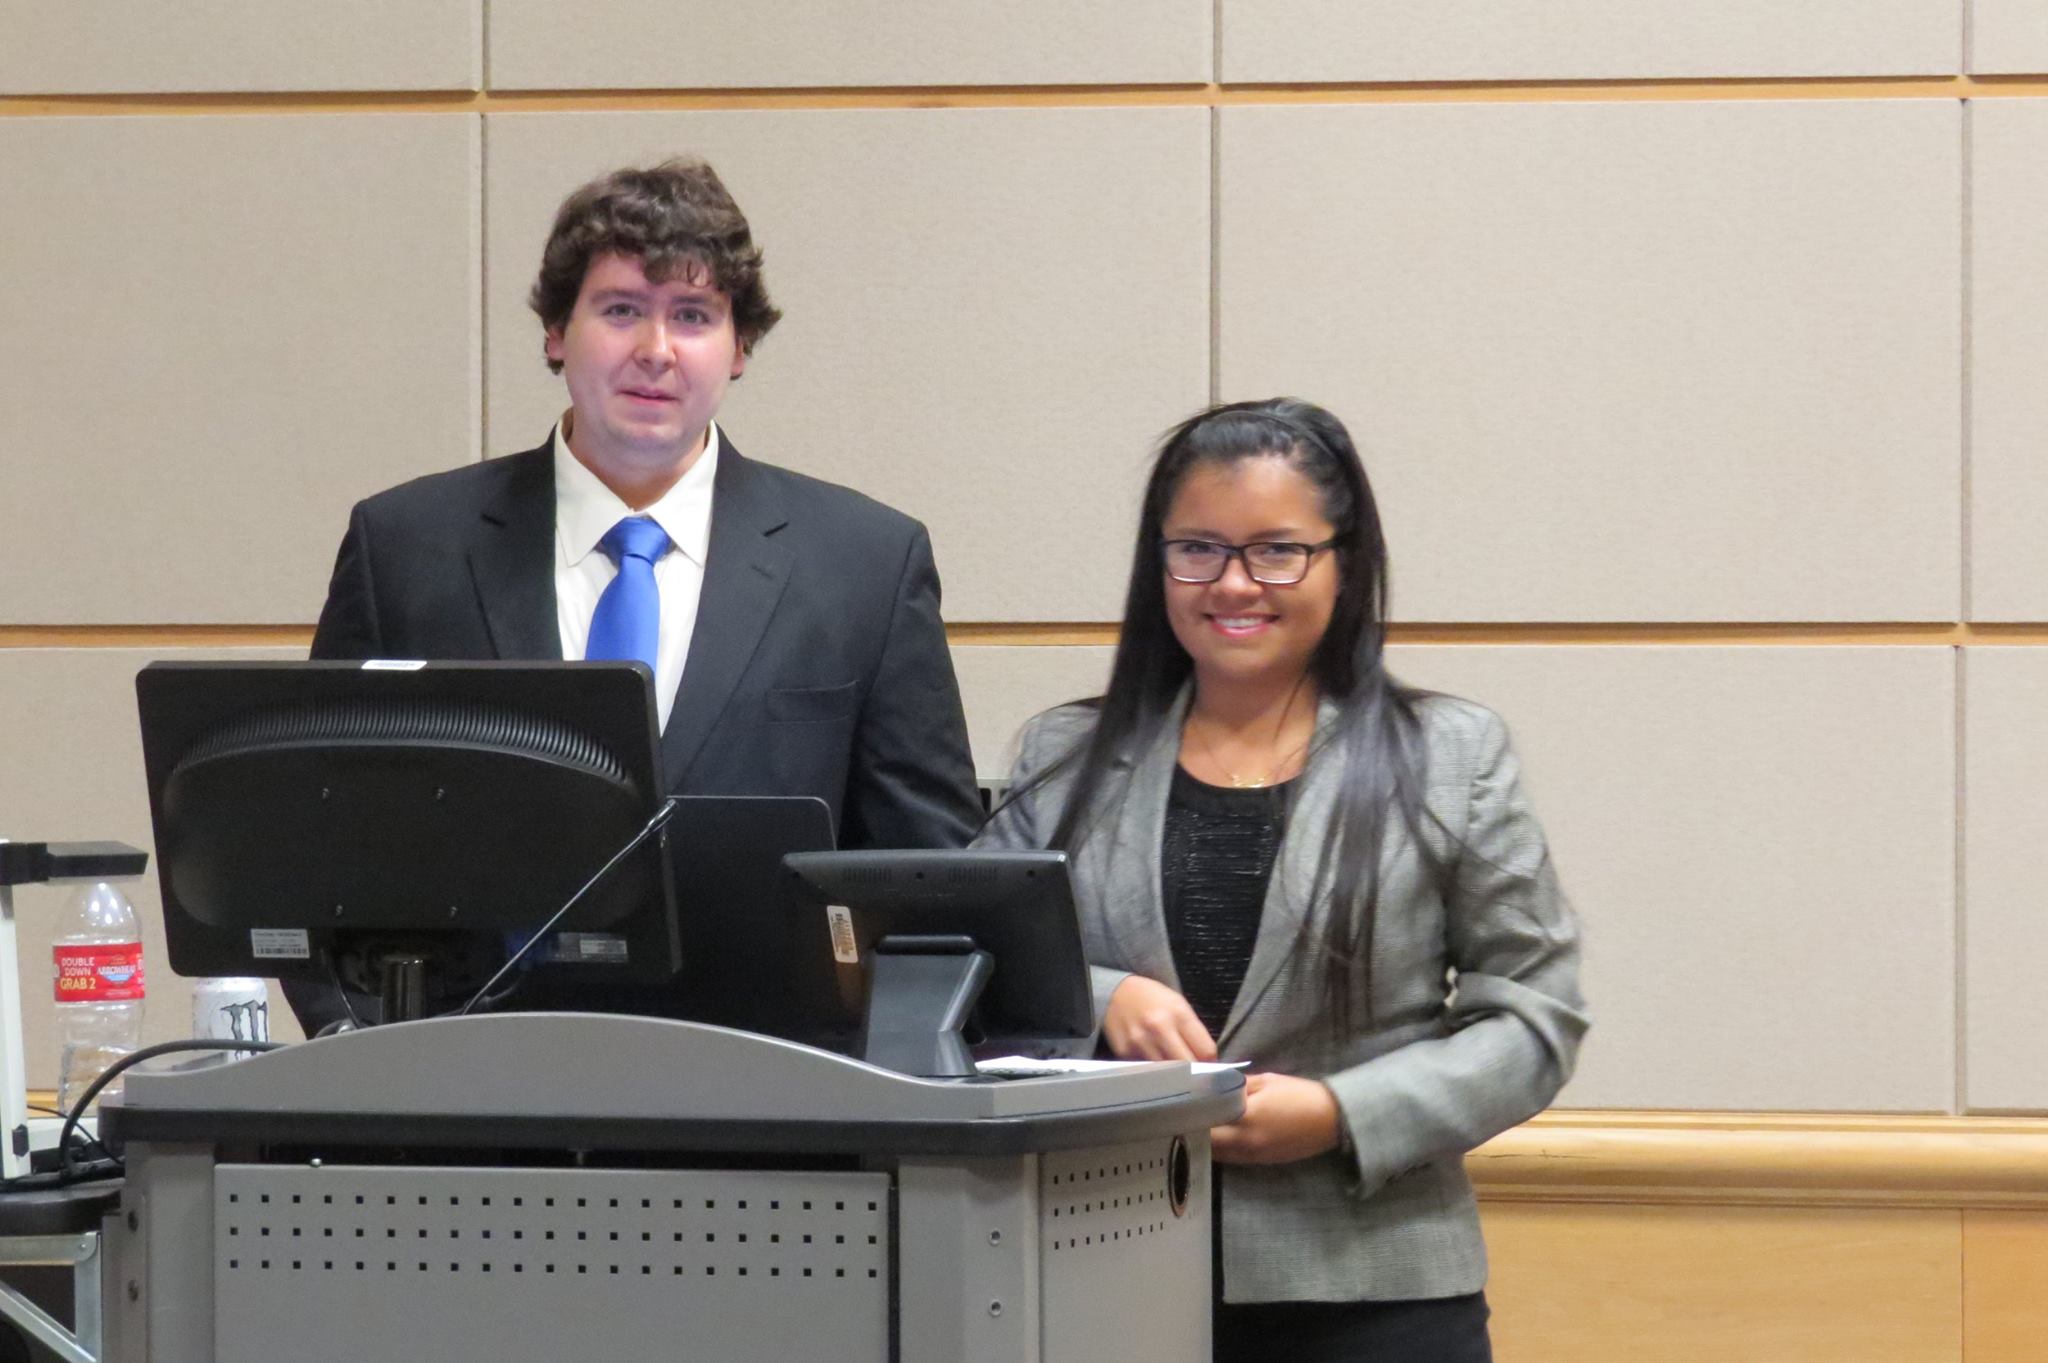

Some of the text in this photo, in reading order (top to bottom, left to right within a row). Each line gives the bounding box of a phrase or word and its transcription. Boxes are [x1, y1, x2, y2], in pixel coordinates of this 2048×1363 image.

[61, 957, 95, 967] DOUBLE
[64, 967, 91, 976] DOWN
[60, 977, 96, 990] GRAB 2
